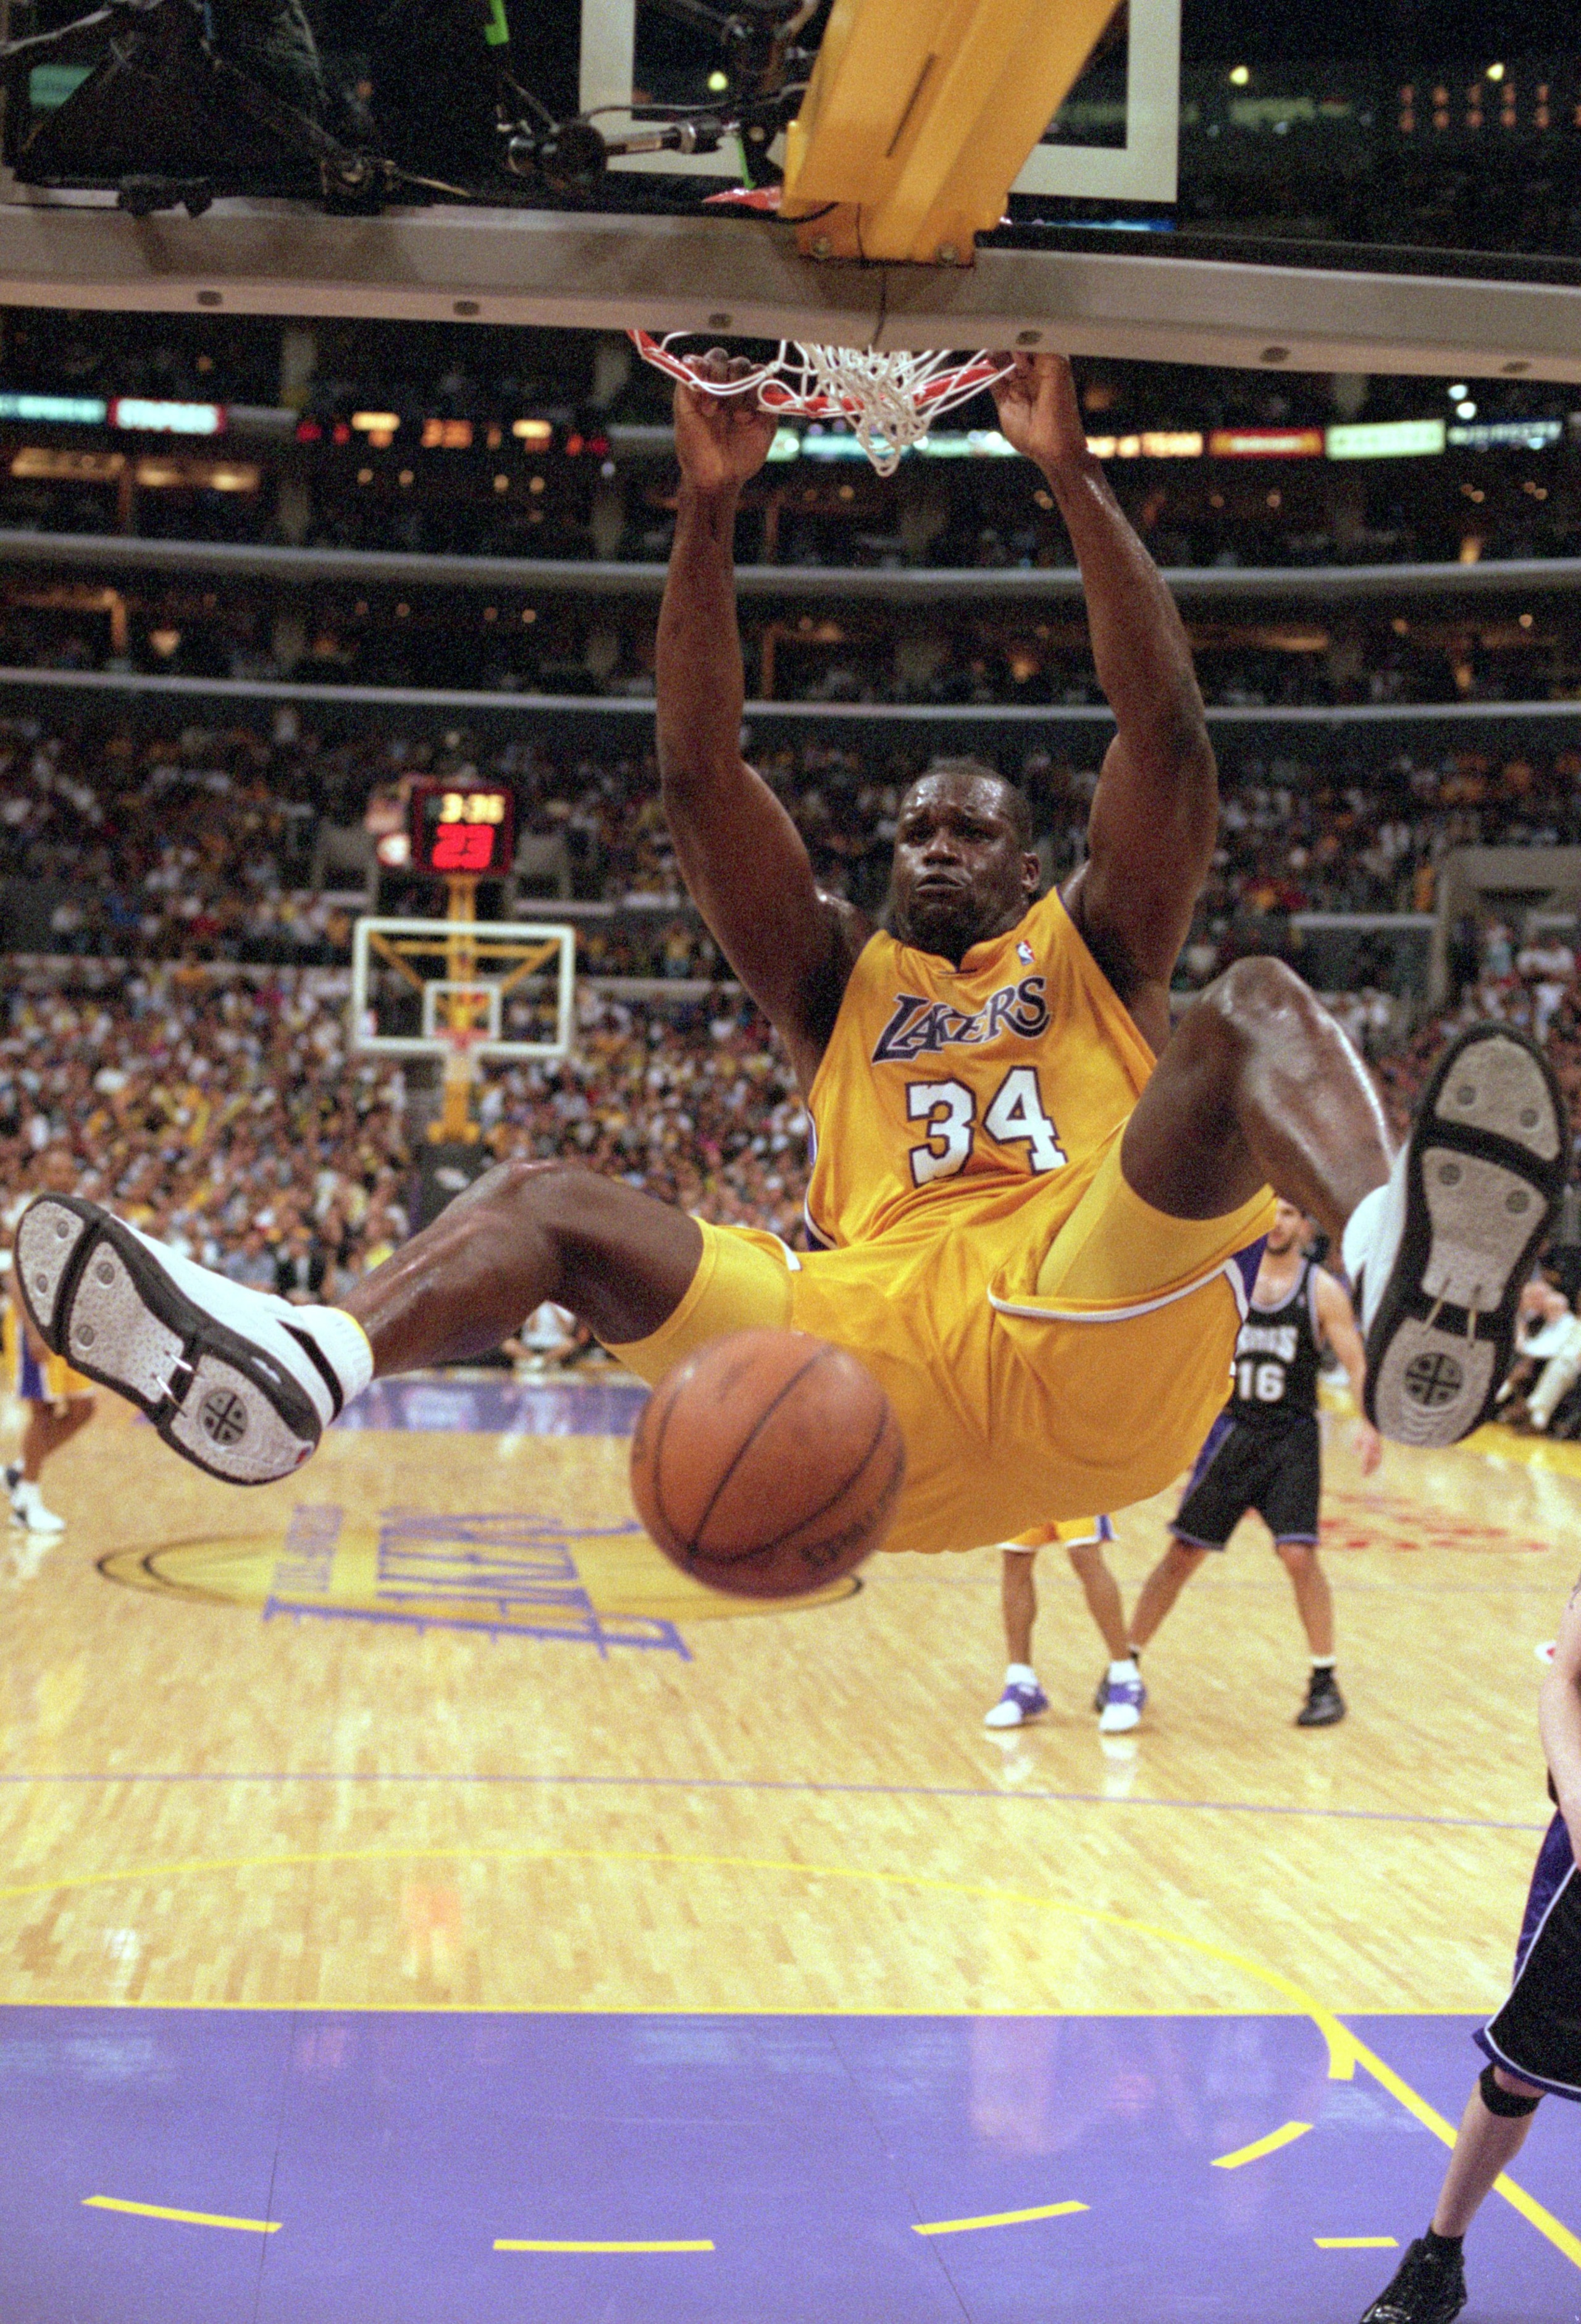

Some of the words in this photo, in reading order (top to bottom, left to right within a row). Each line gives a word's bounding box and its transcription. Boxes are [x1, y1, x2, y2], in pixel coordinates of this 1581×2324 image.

[871, 976, 1051, 1064] LAKERS
[905, 1066, 1068, 1187] 34
[1238, 1360, 1285, 1402] 16
